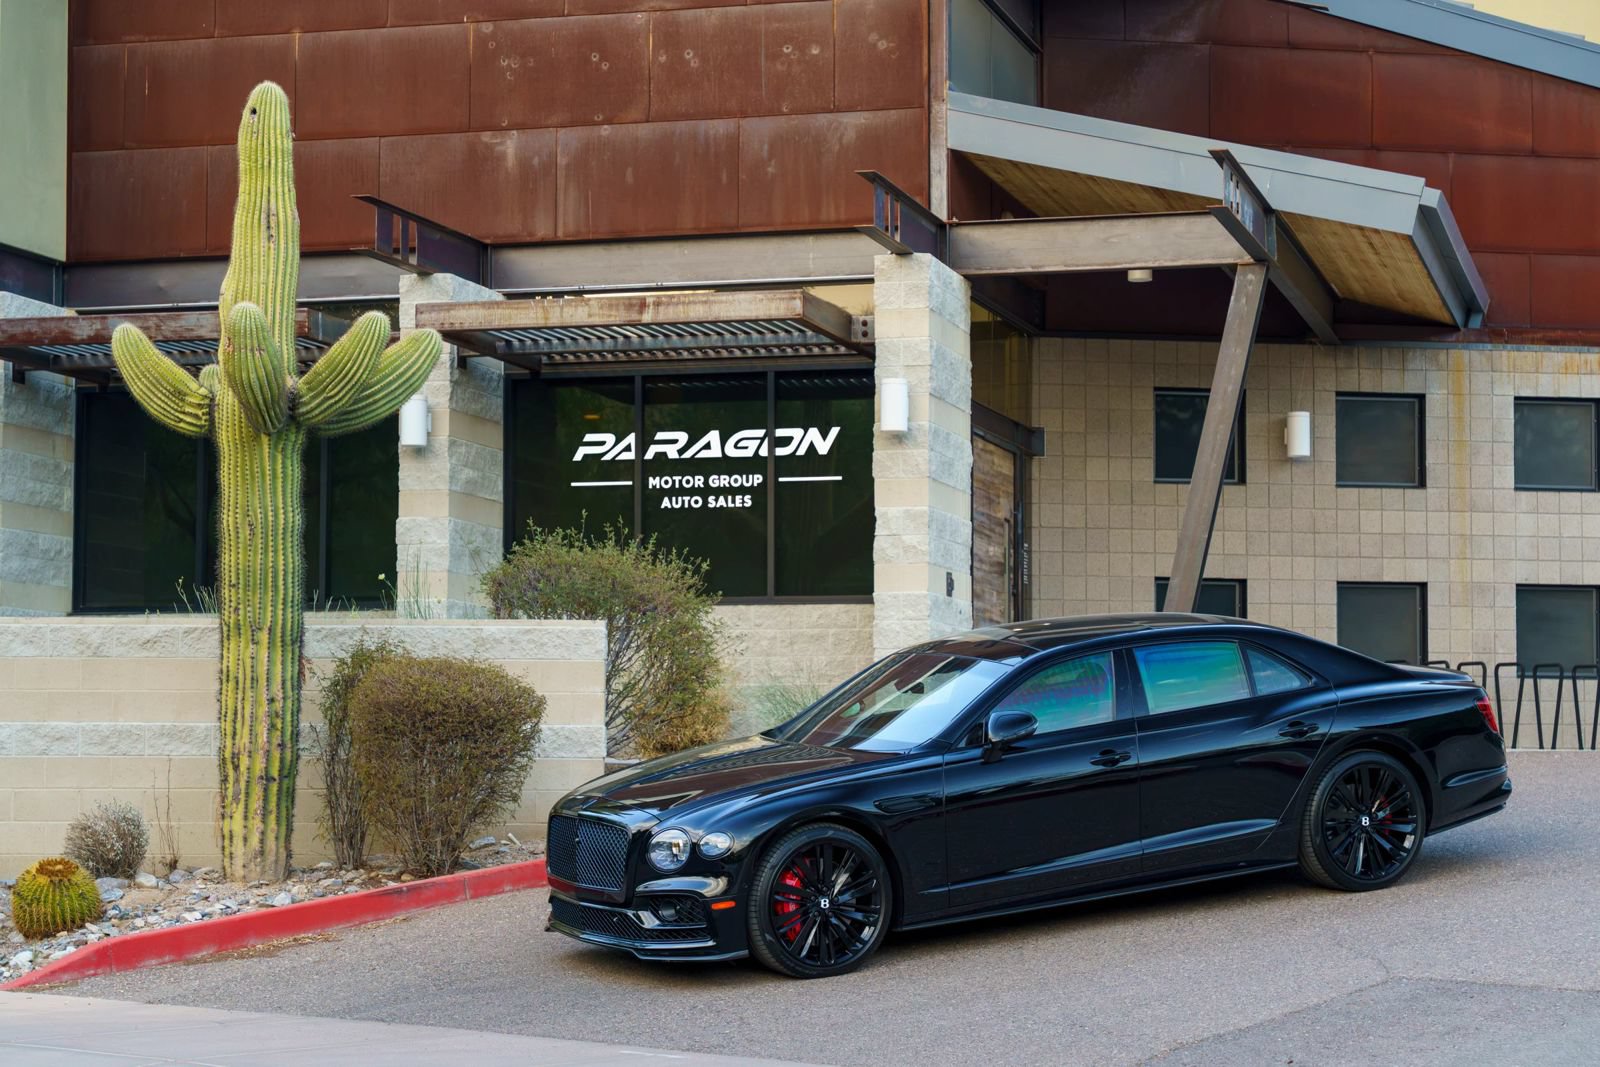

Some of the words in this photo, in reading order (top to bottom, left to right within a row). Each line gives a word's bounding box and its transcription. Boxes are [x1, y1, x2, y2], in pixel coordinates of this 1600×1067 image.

[572, 426, 841, 461] PARAGON
[648, 475, 705, 489] MOTOR
[708, 474, 763, 488] GROUP
[660, 496, 703, 509] AUTO
[707, 495, 753, 508] SALES
[1361, 816, 1370, 826] B
[820, 898, 830, 909] B
